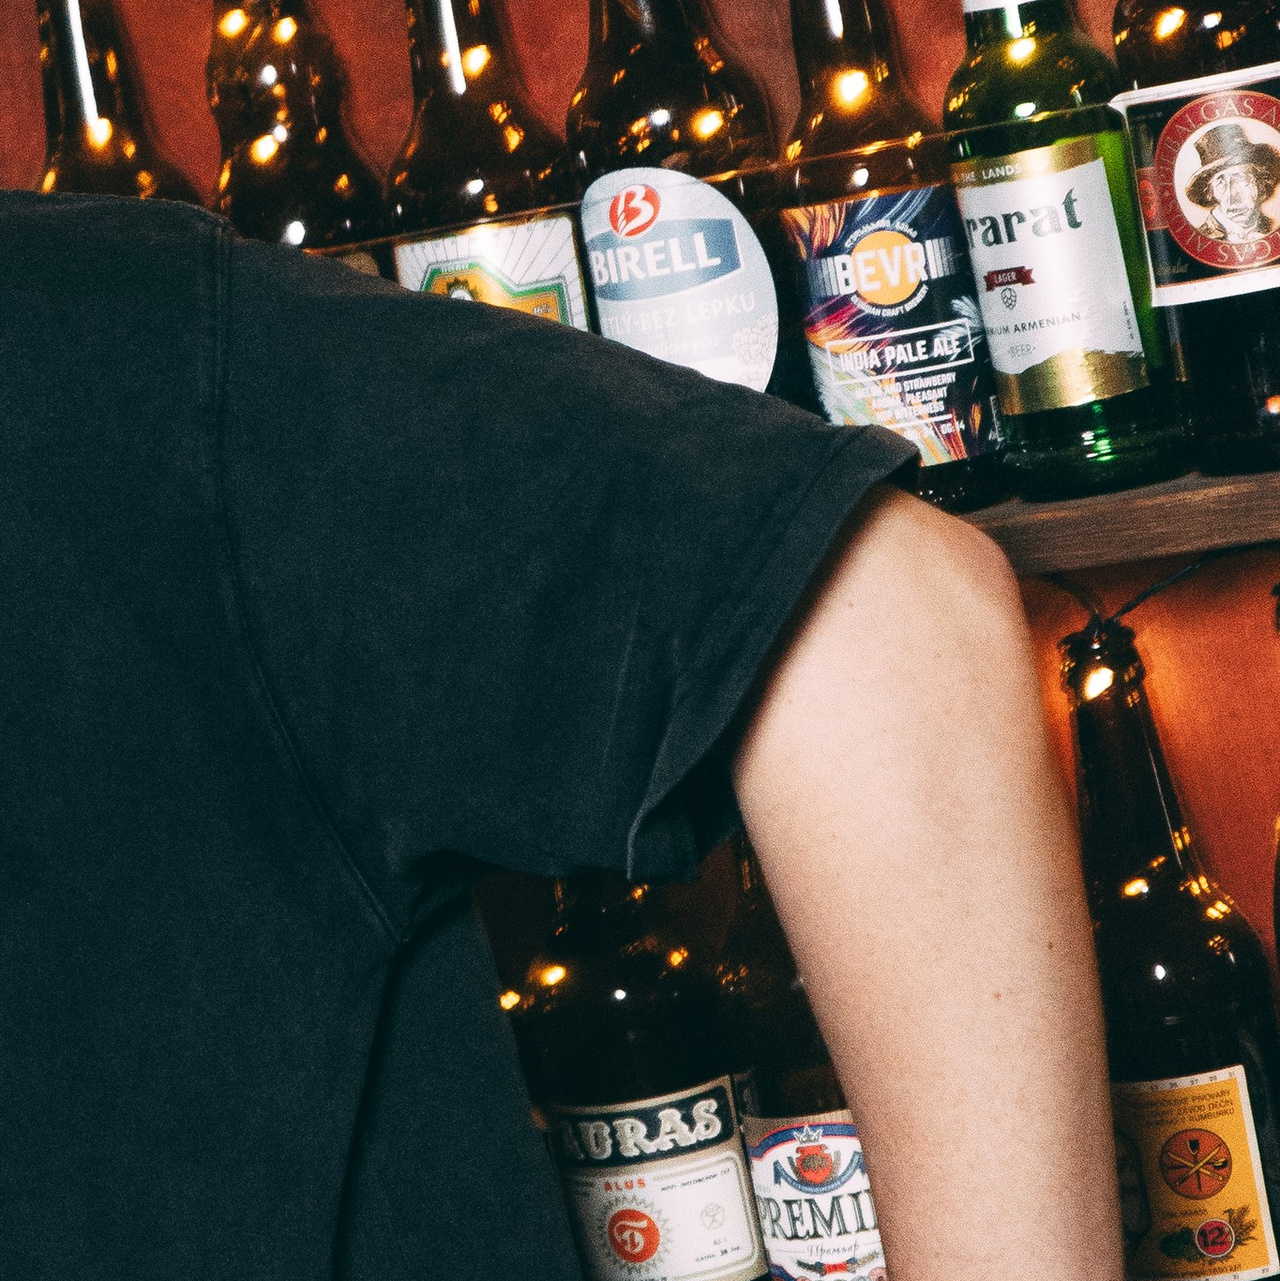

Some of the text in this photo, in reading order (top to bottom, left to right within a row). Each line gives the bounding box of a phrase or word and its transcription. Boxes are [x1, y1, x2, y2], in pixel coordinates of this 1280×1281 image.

[982, 164, 1022, 181] LANDS
[965, 187, 1083, 249] rarat
[590, 231, 721, 287] BIRELL
[994, 271, 1017, 285] LAGER
[1014, 311, 1081, 333] ARMENIAN
[839, 334, 963, 373] INDIA PALE ALE
[904, 372, 956, 391] STRAWBERRY
[905, 386, 948, 404] PLEASANT
[577, 1099, 721, 1160] URAS
